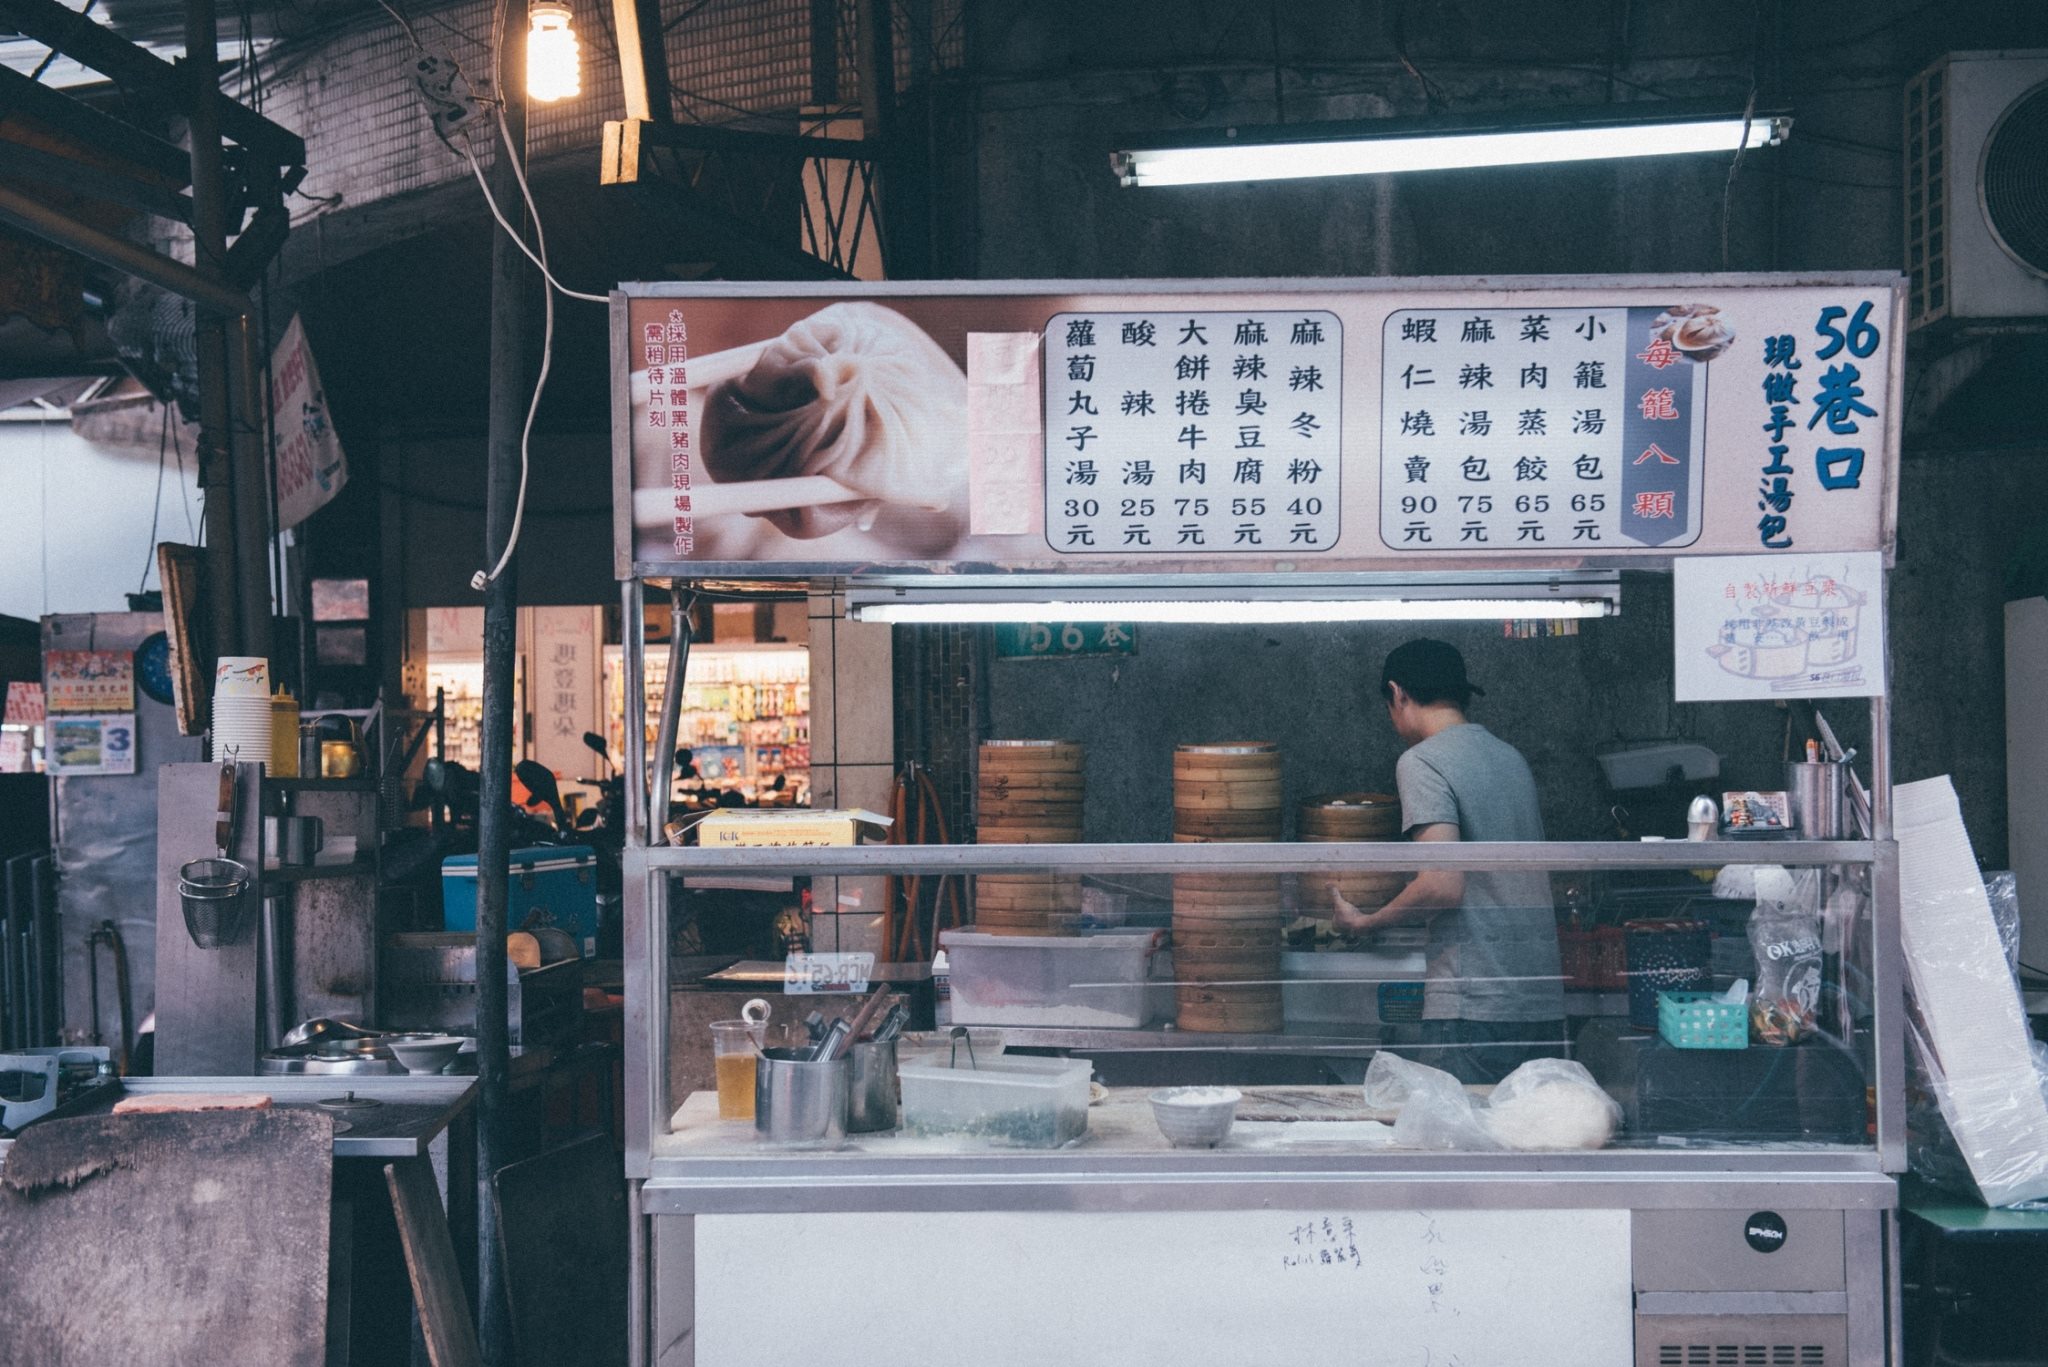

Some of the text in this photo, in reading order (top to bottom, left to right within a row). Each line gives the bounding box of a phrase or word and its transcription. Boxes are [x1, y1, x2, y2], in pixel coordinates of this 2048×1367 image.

[644, 324, 667, 428] 需稍待片刻
[666, 324, 694, 554] 採用溫體黑豬肉現場製作
[1632, 339, 1683, 519] 每籠八顆
[1756, 335, 1803, 548] 現做手工湯包
[1807, 301, 1880, 492] 56巷口
[107, 728, 131, 751] 3
